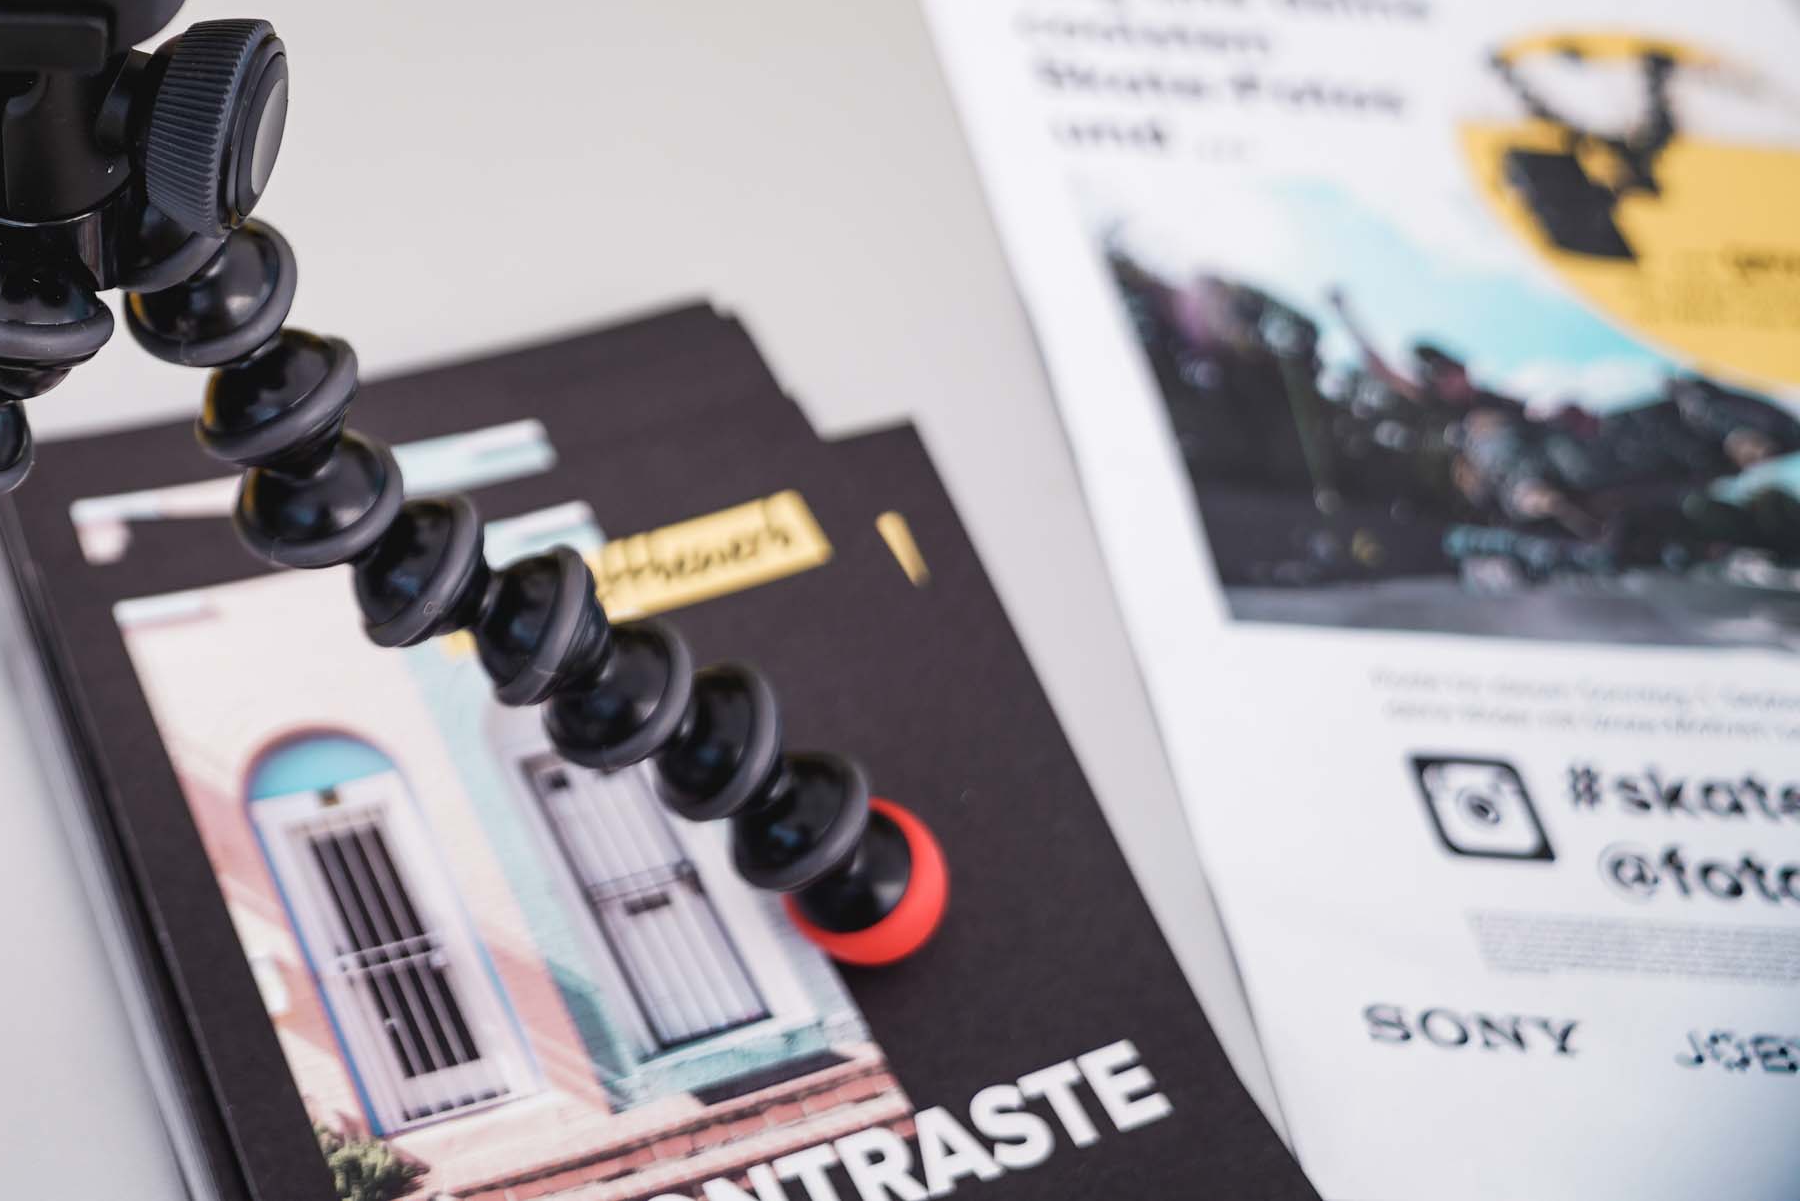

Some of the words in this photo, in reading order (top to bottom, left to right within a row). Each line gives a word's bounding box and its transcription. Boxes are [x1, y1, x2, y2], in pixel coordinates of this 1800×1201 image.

[1363, 1003, 1581, 1058] SONY
[1674, 1029, 1800, 1073] JOB
[647, 1038, 1174, 1201] TRASTE
